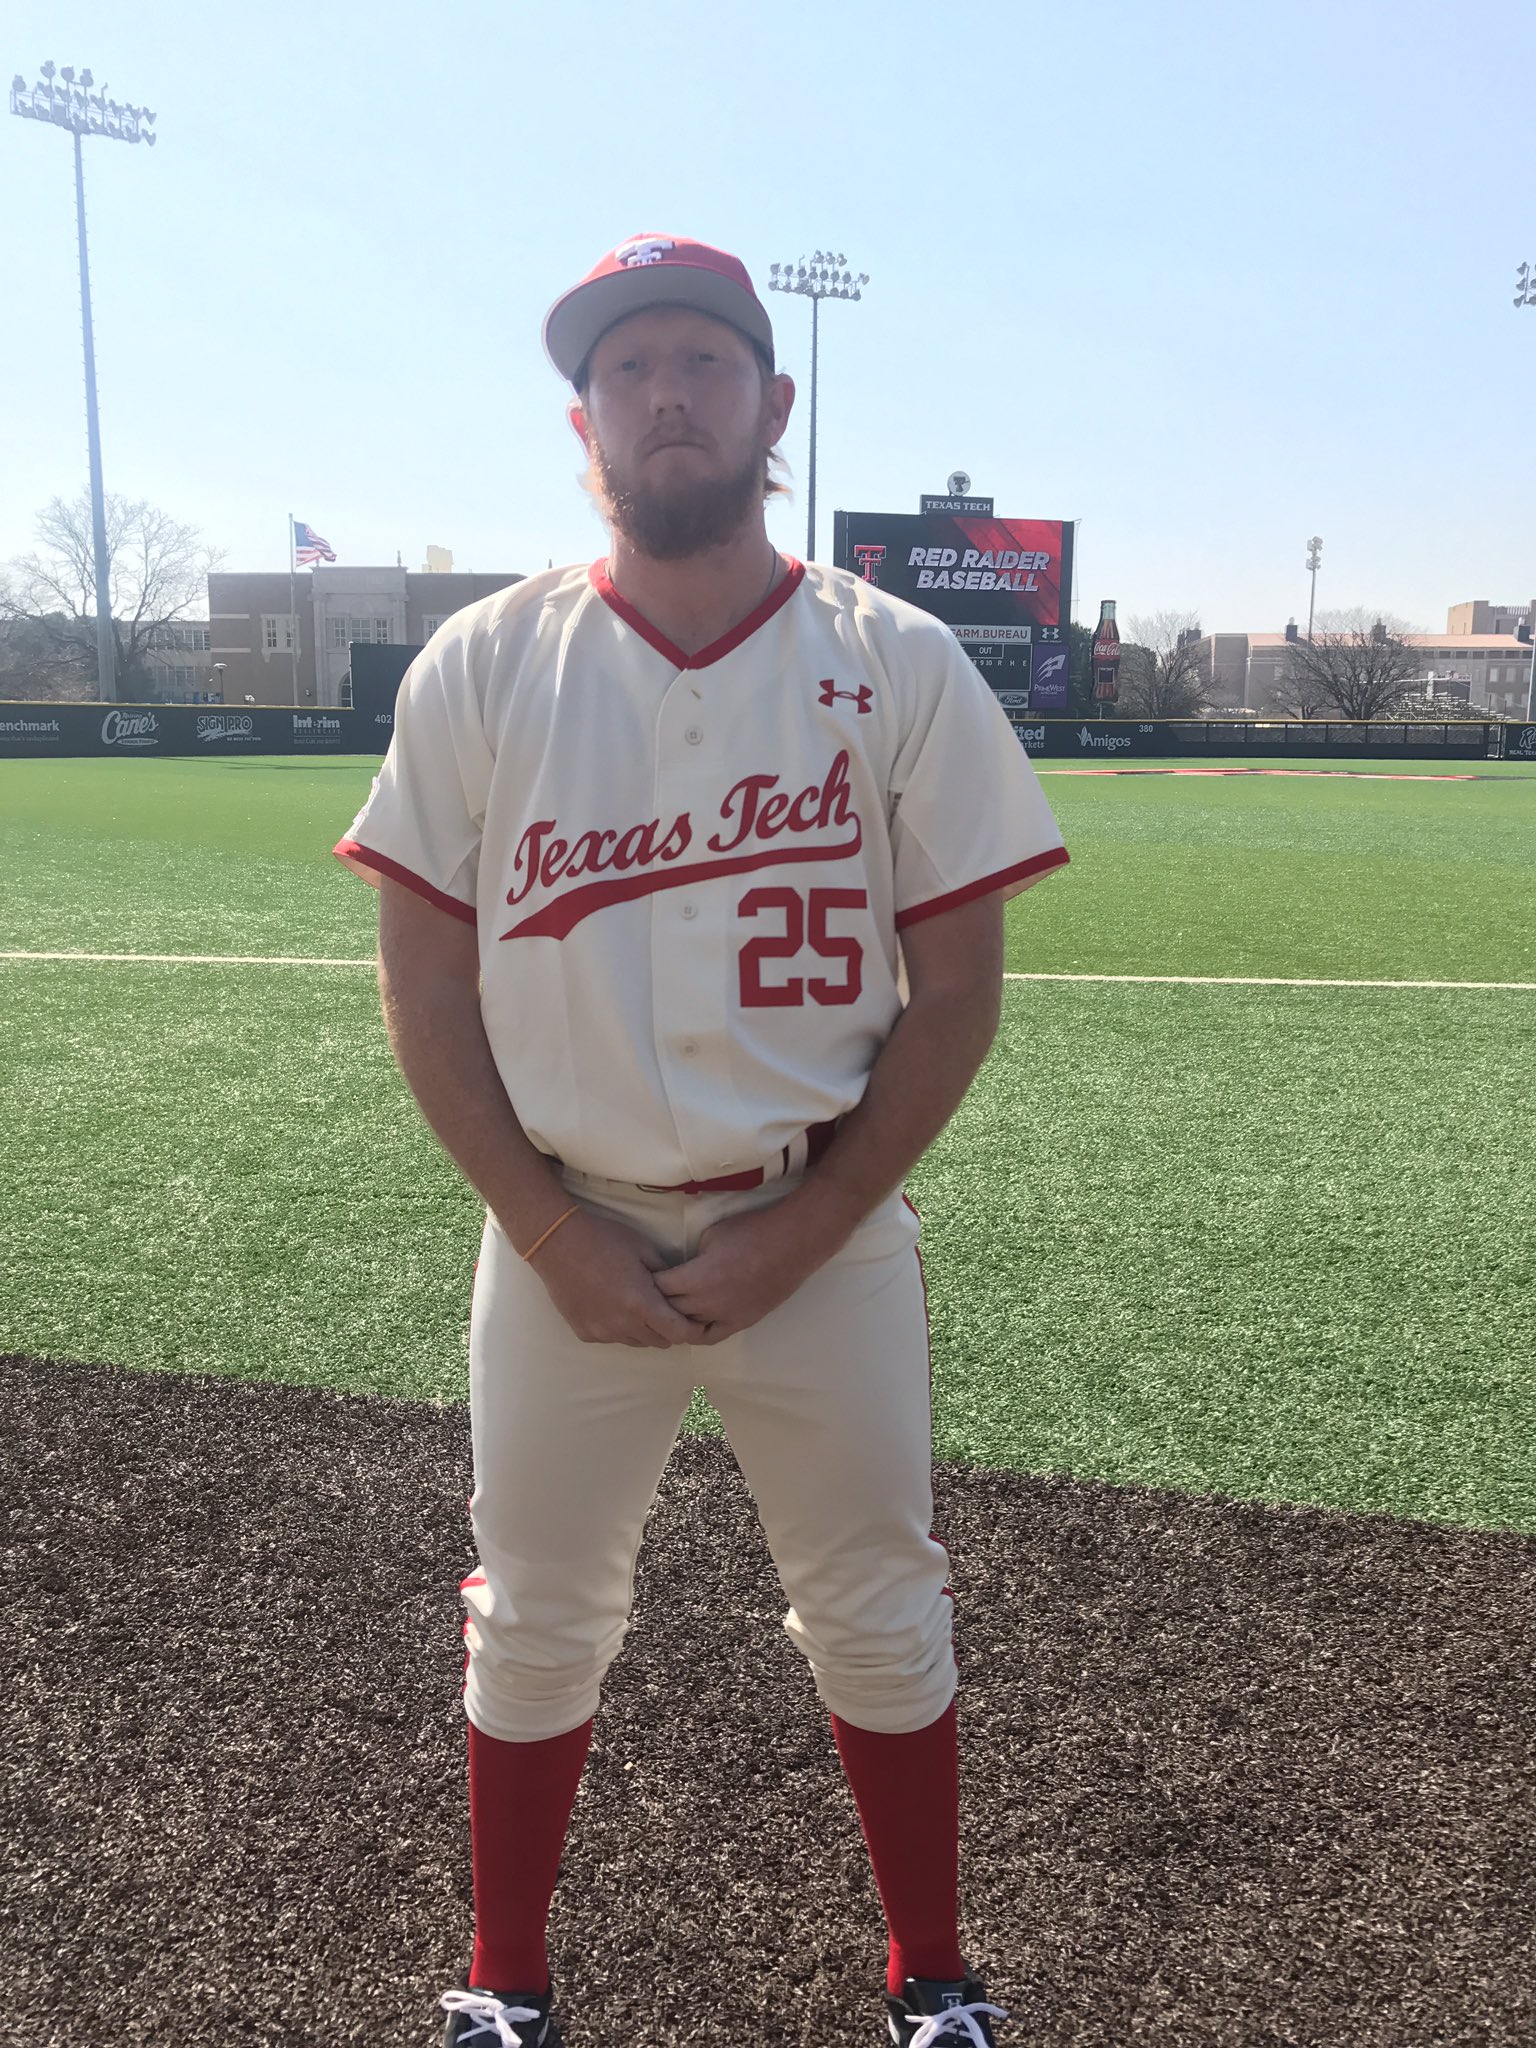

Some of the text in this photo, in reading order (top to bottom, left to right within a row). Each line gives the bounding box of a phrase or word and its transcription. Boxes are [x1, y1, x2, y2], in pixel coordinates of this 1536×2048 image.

[925, 500, 990, 511] TEXAS TECH
[908, 547, 1050, 570] RED RAIDER
[916, 570, 1039, 591] BASEBALL
[979, 646, 993, 655] OUT
[101, 710, 159, 745] Cane's
[196, 715, 253, 733] SIGN PRO
[374, 714, 393, 724] 402
[1138, 724, 1154, 733] 380
[1085, 732, 1132, 750] Amigos
[506, 749, 861, 905] Texas Tech
[738, 887, 868, 1007] 25
